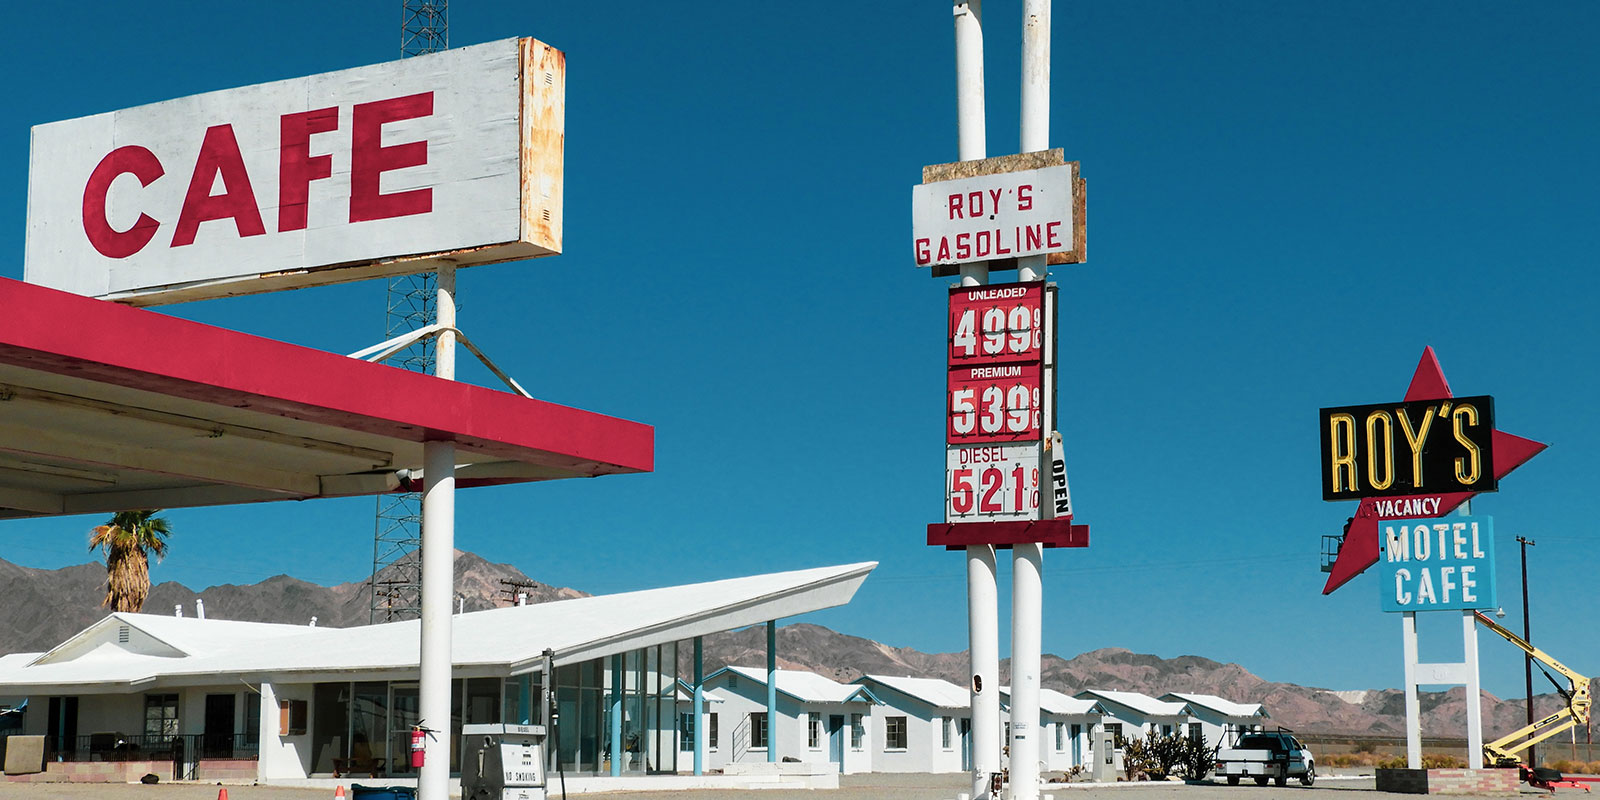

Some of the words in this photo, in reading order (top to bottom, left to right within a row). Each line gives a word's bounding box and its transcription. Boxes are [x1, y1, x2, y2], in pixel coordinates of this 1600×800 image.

[82, 91, 434, 259] CAFE
[949, 185, 1033, 220] ROY'S
[915, 221, 1062, 265] GASOLINE
[968, 287, 1027, 301] UNLEADED
[954, 305, 1031, 356] 499
[971, 366, 1022, 379] PREMIUM
[953, 384, 1031, 434] 539
[960, 446, 1008, 464] DIESEL
[1330, 400, 1481, 493] ROY'S
[952, 467, 1025, 513] 521
[1031, 468, 1039, 488] 9
[1052, 459, 1069, 514] OPEN
[1375, 497, 1441, 517] VACANCY
[1385, 522, 1485, 563] MOTEL
[1395, 566, 1477, 605] CAFE
